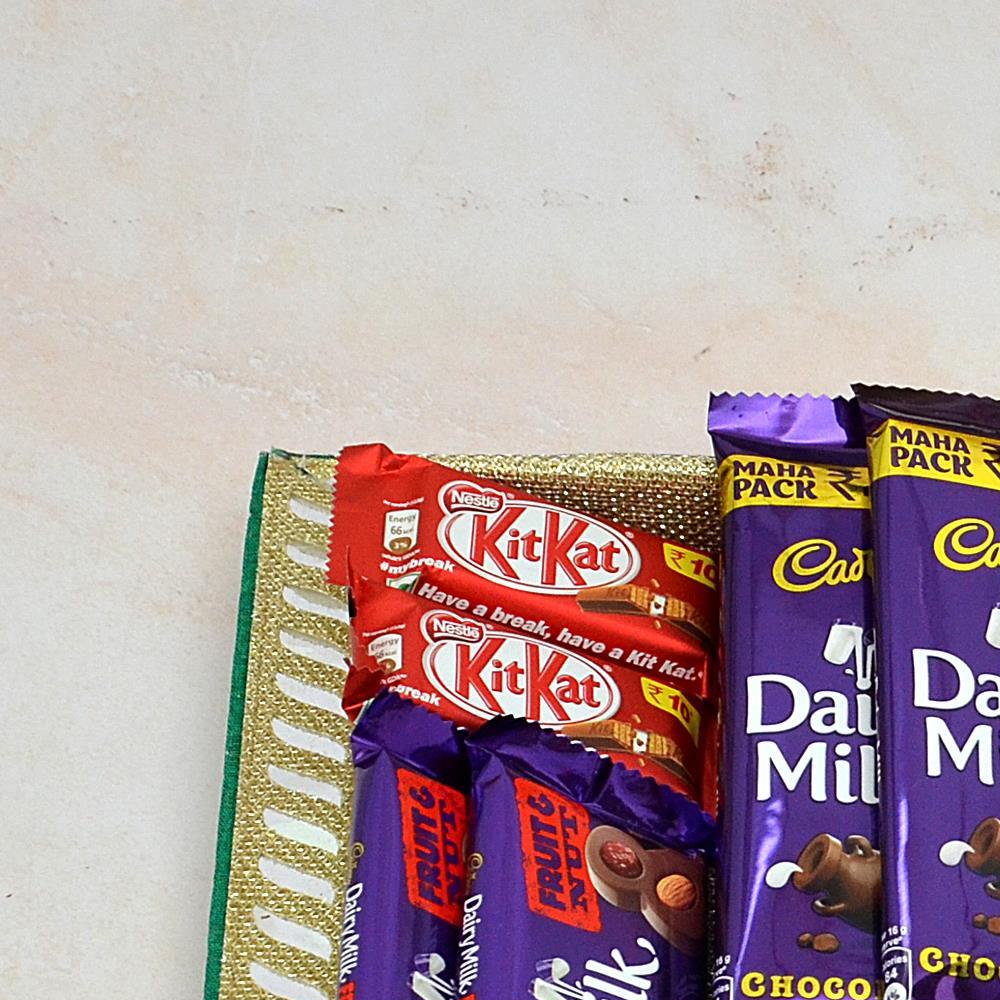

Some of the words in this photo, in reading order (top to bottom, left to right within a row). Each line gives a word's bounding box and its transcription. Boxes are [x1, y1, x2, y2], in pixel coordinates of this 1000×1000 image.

[890, 425, 970, 454] MAHA
[890, 446, 974, 478] PACK
[733, 459, 816, 479] MAHA
[733, 477, 818, 500] PACK
[418, 583, 470, 610] Have
[472, 605, 488, 616] a
[490, 607, 551, 639] break,
[557, 628, 606, 653] have
[609, 648, 624, 660] a
[626, 650, 658, 670] Kit
[411, 806, 444, 905] FRUIT
[530, 814, 567, 911] FRUIT
[559, 805, 588, 912] NUT
[459, 894, 483, 947] Dairy
[459, 945, 480, 995] Milk
